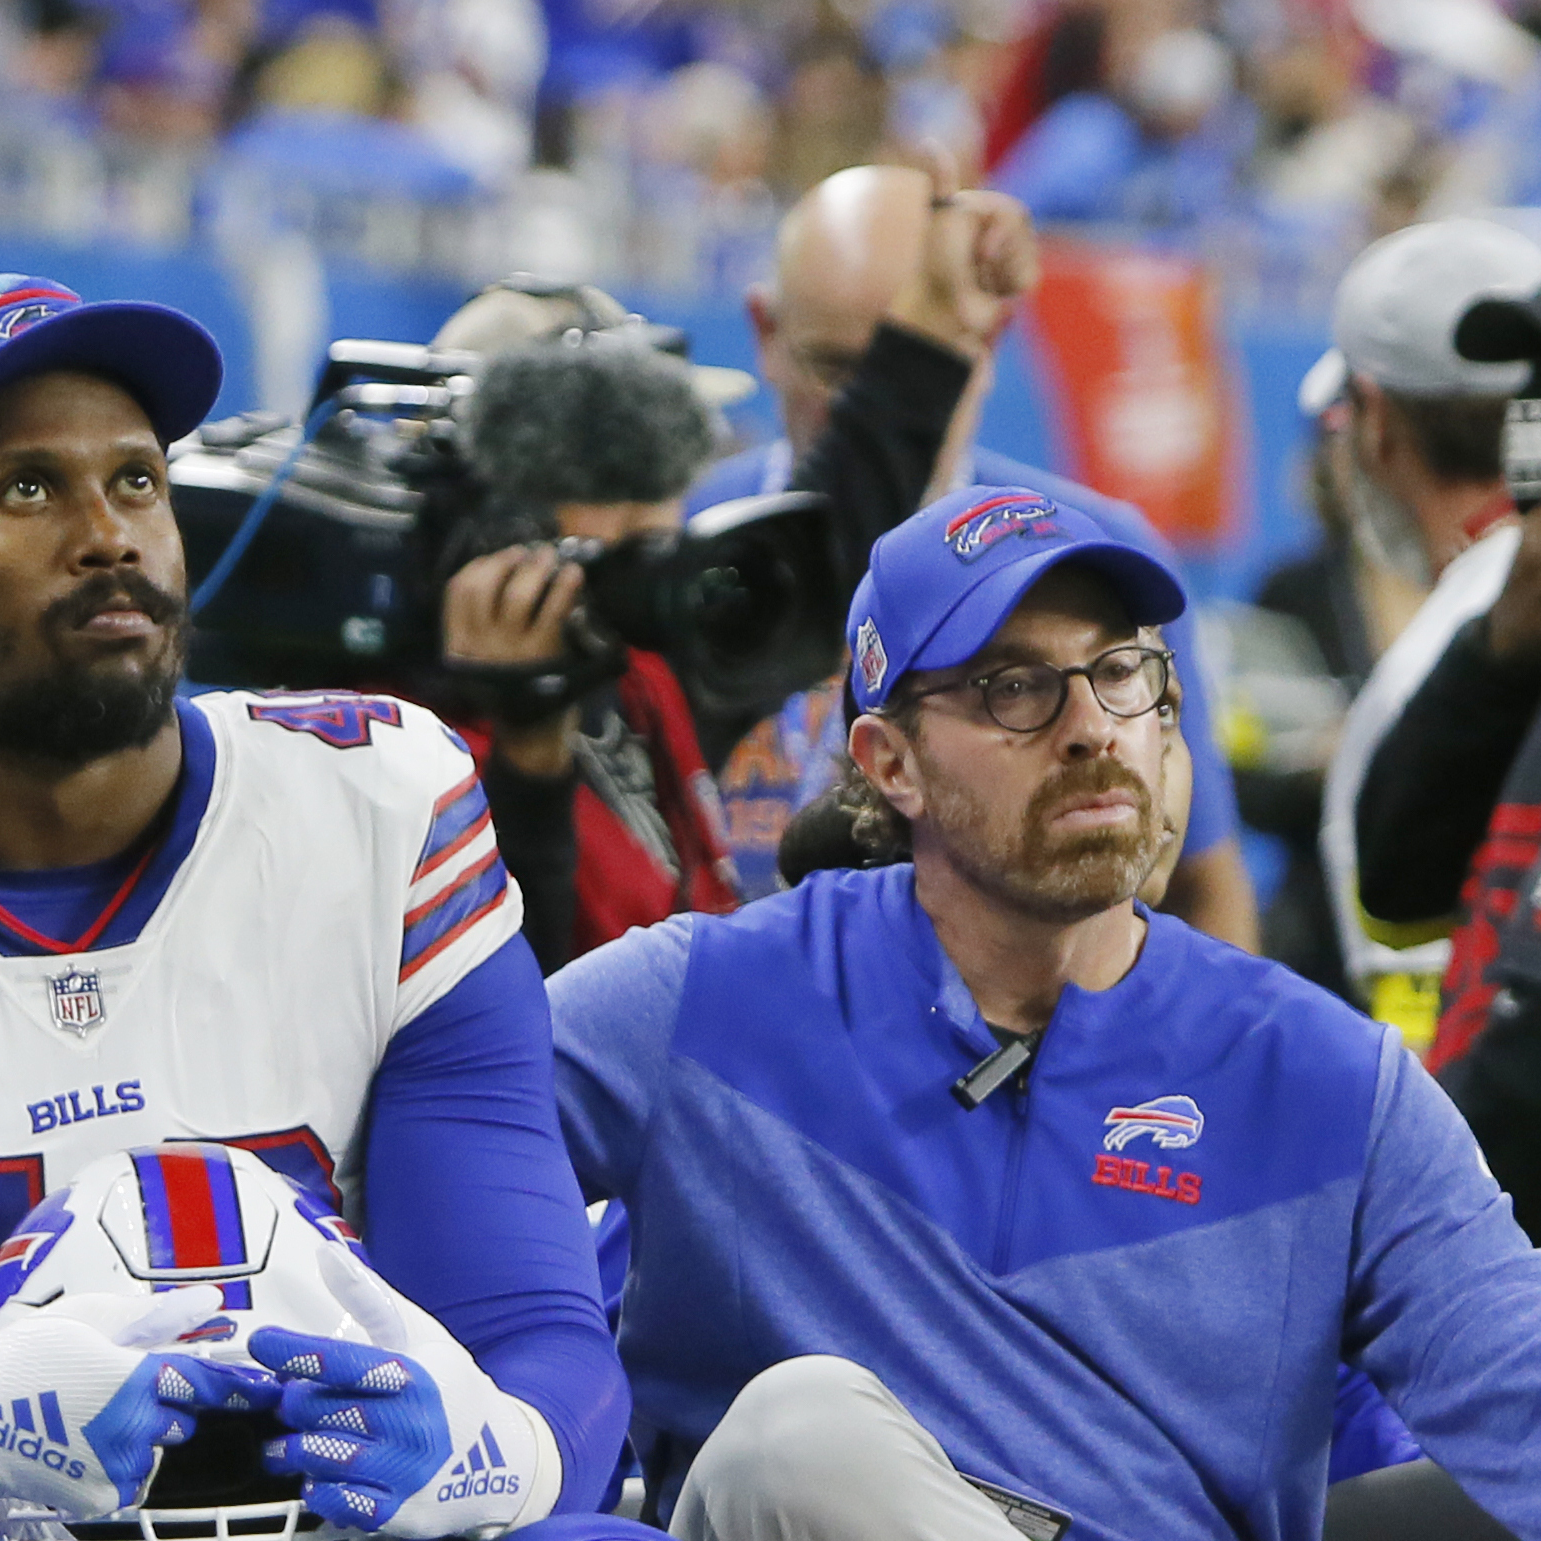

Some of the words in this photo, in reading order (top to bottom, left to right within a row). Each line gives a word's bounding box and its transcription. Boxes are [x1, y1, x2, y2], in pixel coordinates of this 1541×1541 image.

[60, 993, 99, 1022] NFL
[27, 1079, 146, 1134] BILLS
[1091, 1153, 1202, 1205] BILLS
[437, 1470, 520, 1503] adidas
